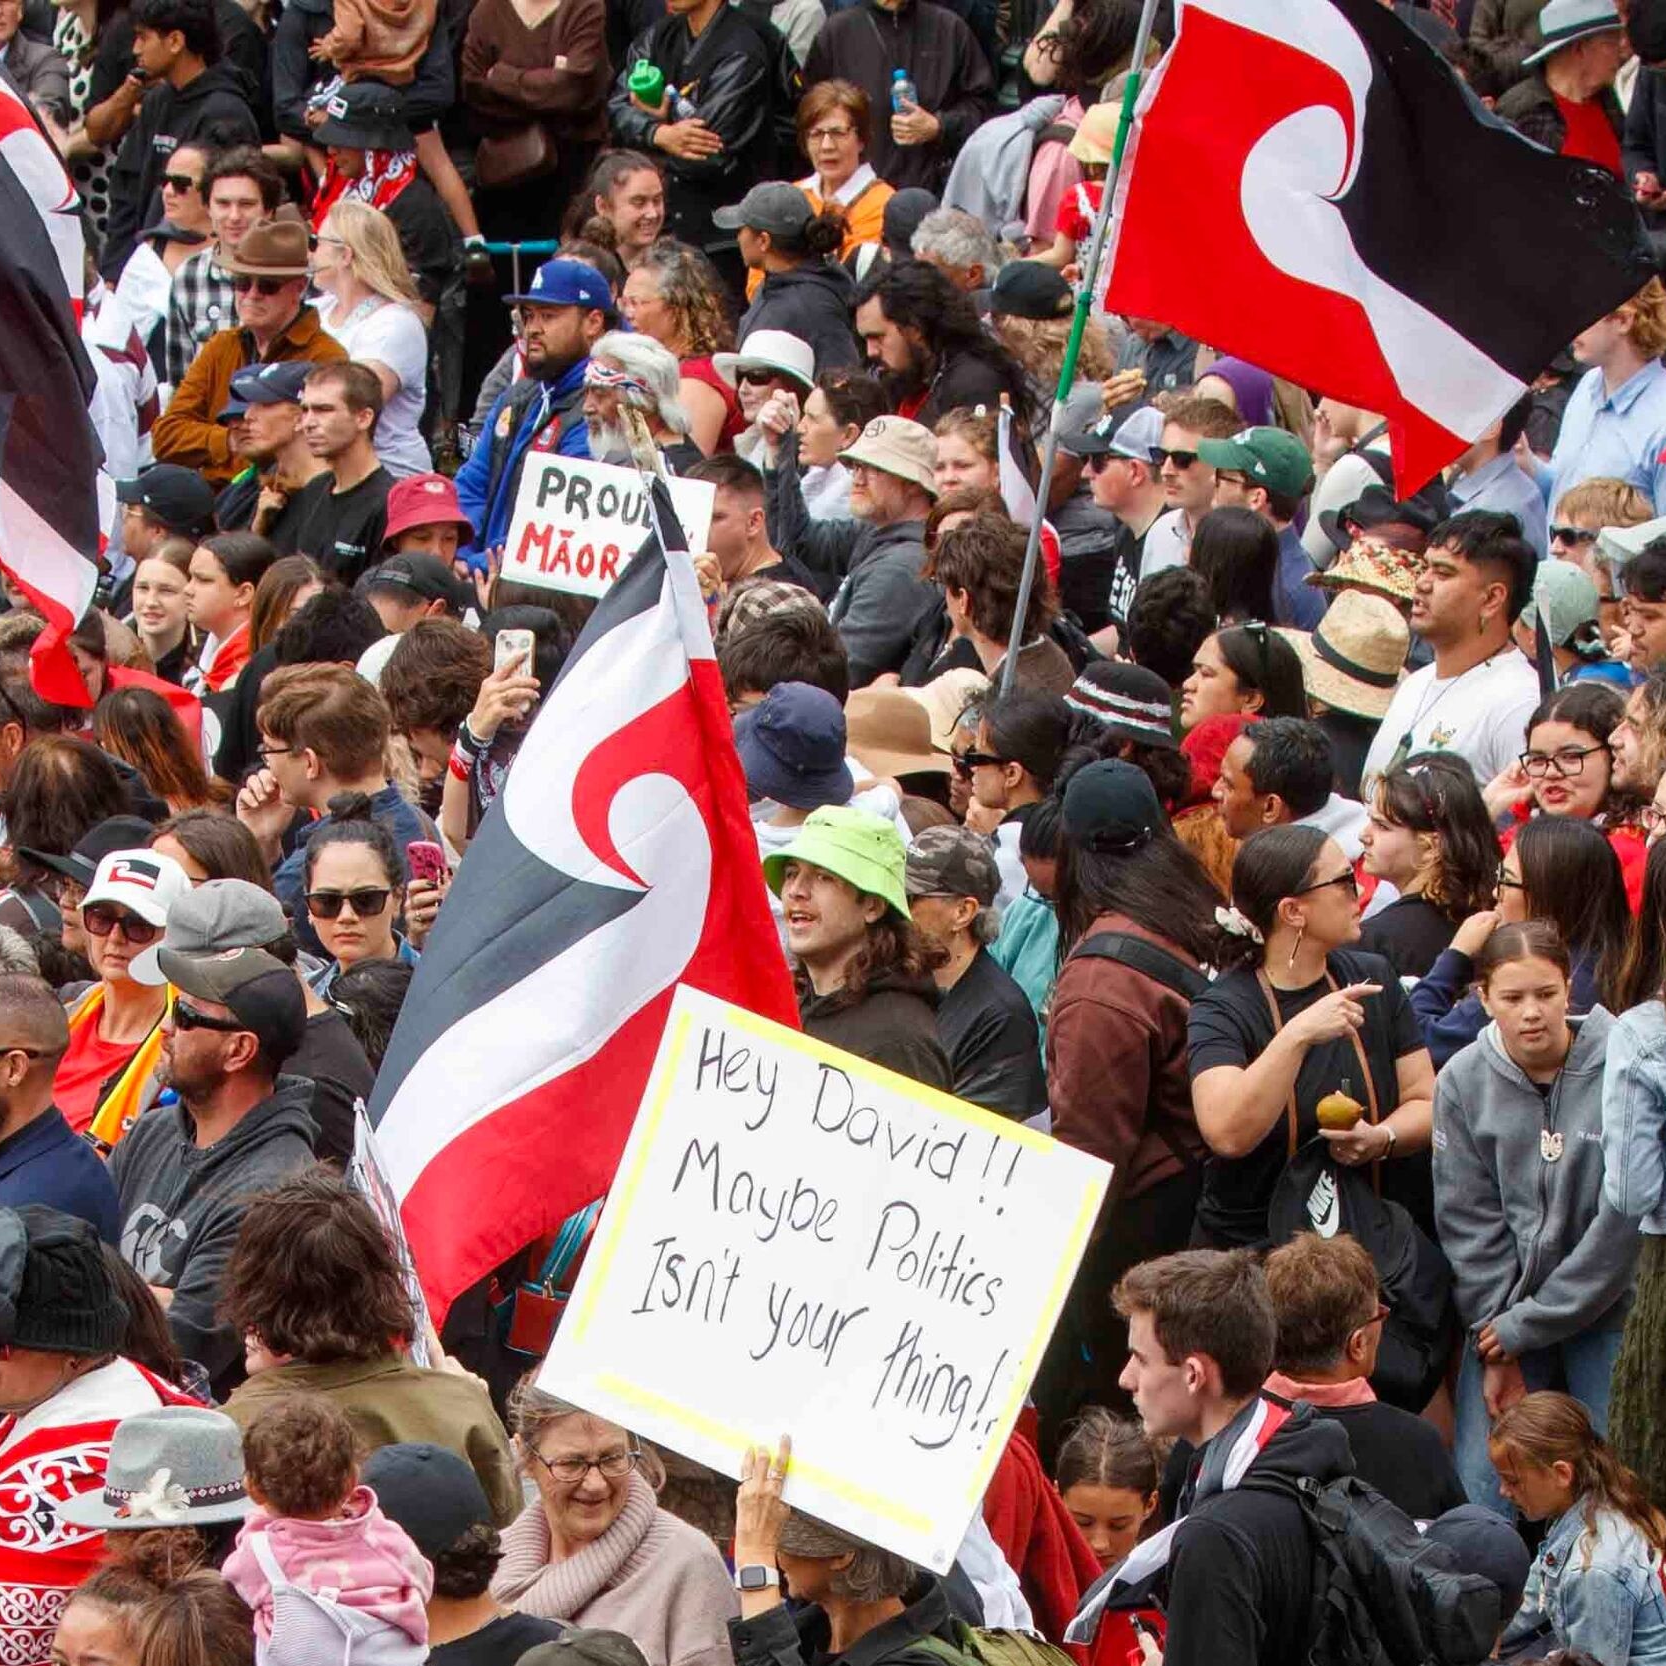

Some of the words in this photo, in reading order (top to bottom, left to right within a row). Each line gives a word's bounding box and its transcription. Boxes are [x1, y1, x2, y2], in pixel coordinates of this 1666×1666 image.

[536, 467, 653, 528] PROU
[516, 521, 638, 582] MĀOR
[696, 1028, 778, 1131] Hey
[673, 1138, 838, 1245] Maybe
[868, 1200, 1003, 1317] Politics
[633, 1236, 742, 1326] Isn't
[751, 1283, 870, 1366] your
